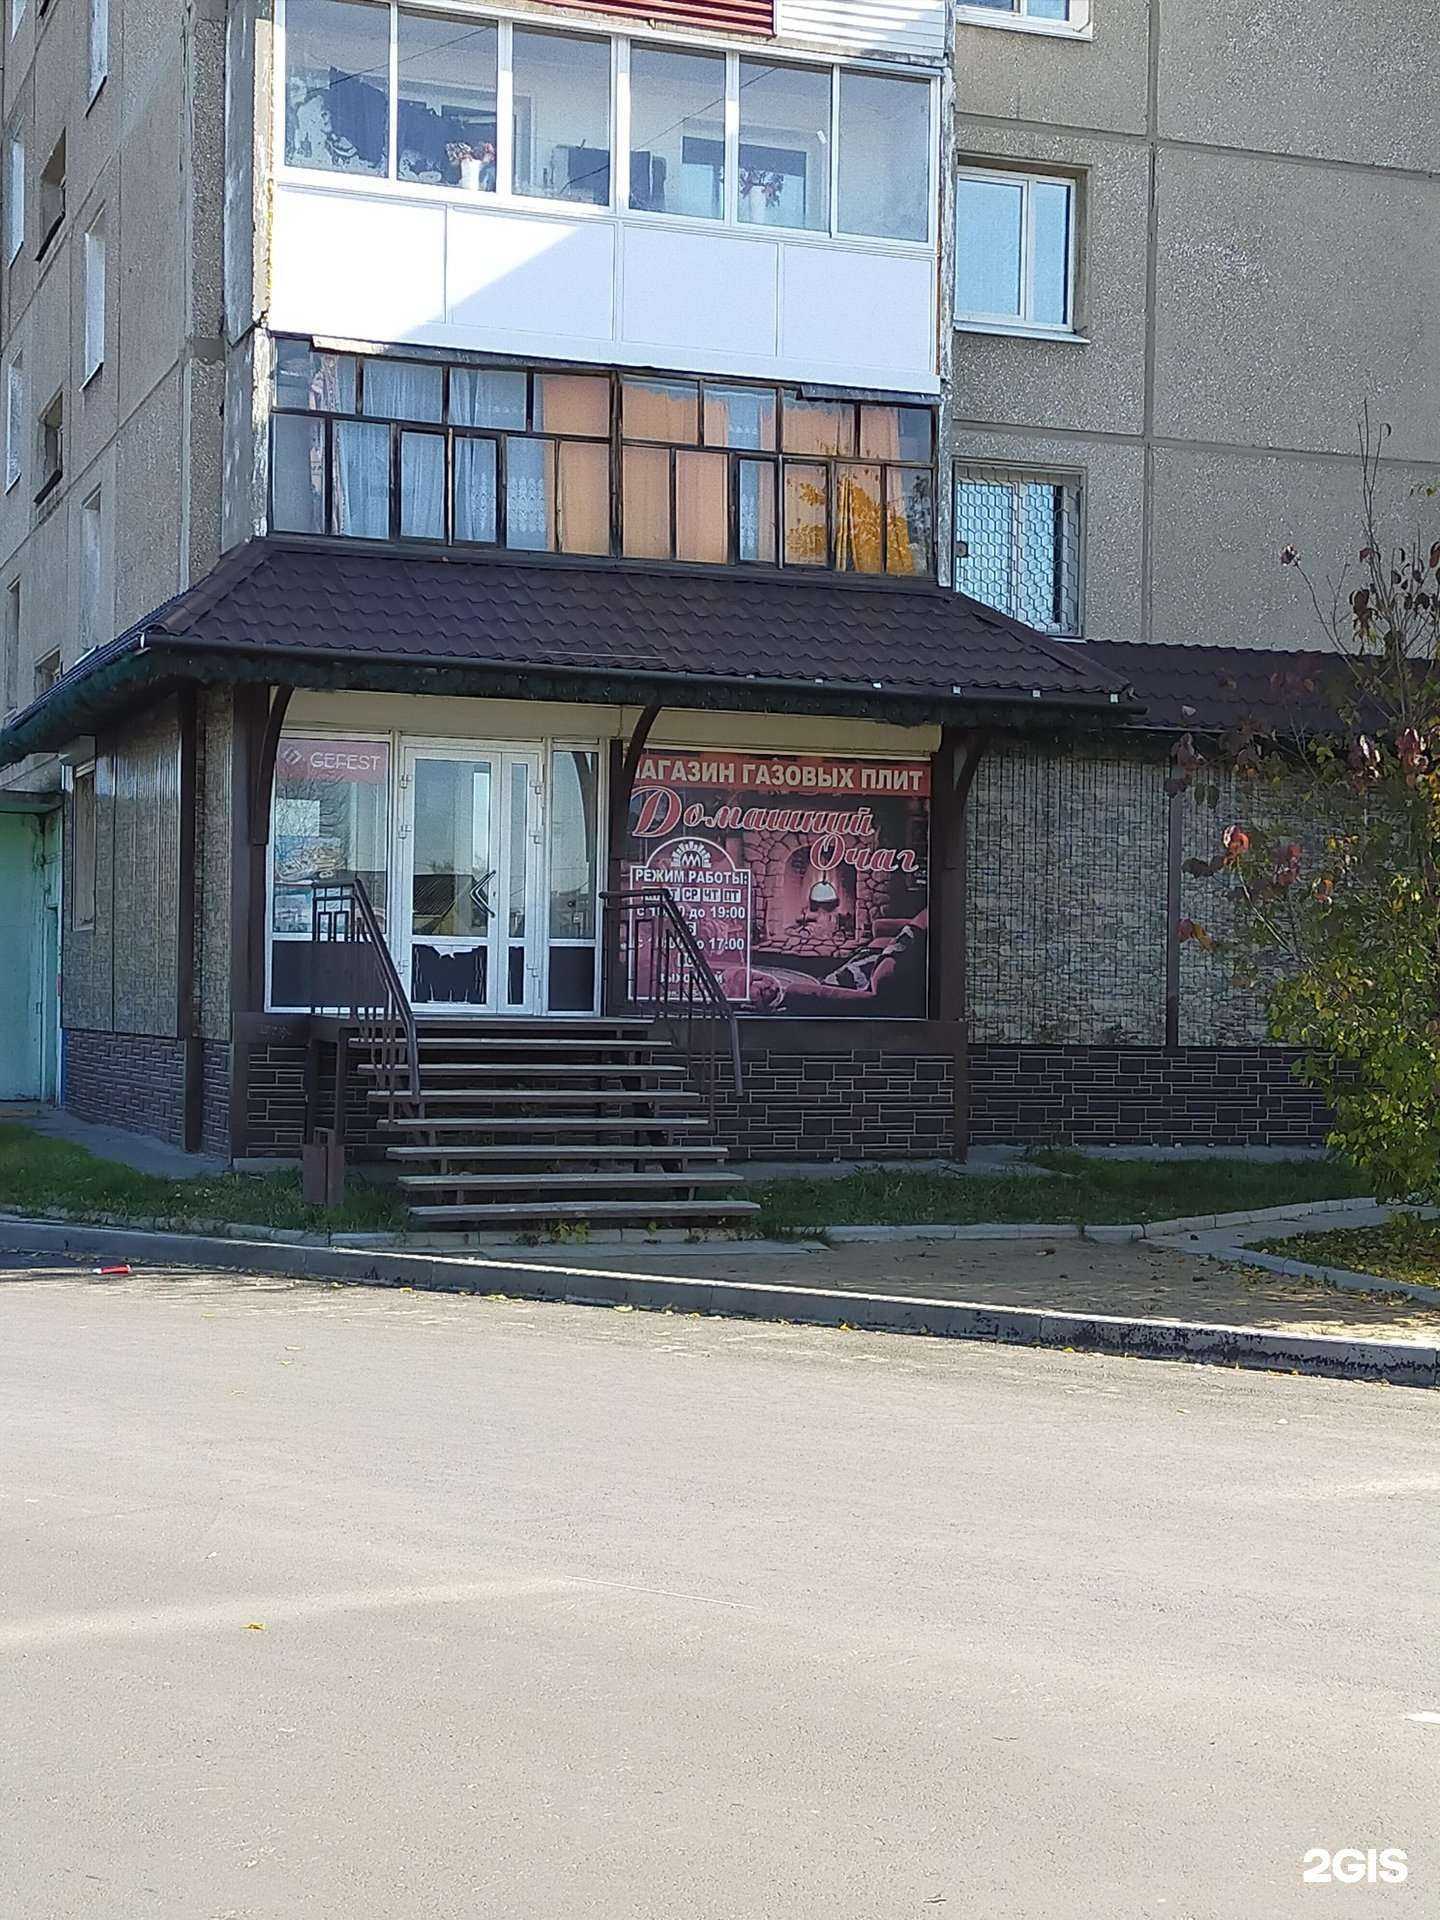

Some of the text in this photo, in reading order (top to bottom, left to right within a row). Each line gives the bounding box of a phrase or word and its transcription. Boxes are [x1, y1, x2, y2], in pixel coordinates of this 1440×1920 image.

[310, 751, 381, 771] GEFEST
[635, 759, 923, 791] АГАЗИН ГАЗОВЫХ ПЛИТ
[631, 785, 876, 838] Домашний
[809, 832, 919, 872] Очаг
[635, 869, 748, 885] РЕЖИМ РАБОТЫ:
[683, 888, 699, 901] СР
[703, 889, 719, 901] ЧТ
[723, 890, 740, 901] ПТ
[688, 909, 705, 920] до
[711, 906, 746, 918] 19:00
[708, 937, 745, 950] 17:00
